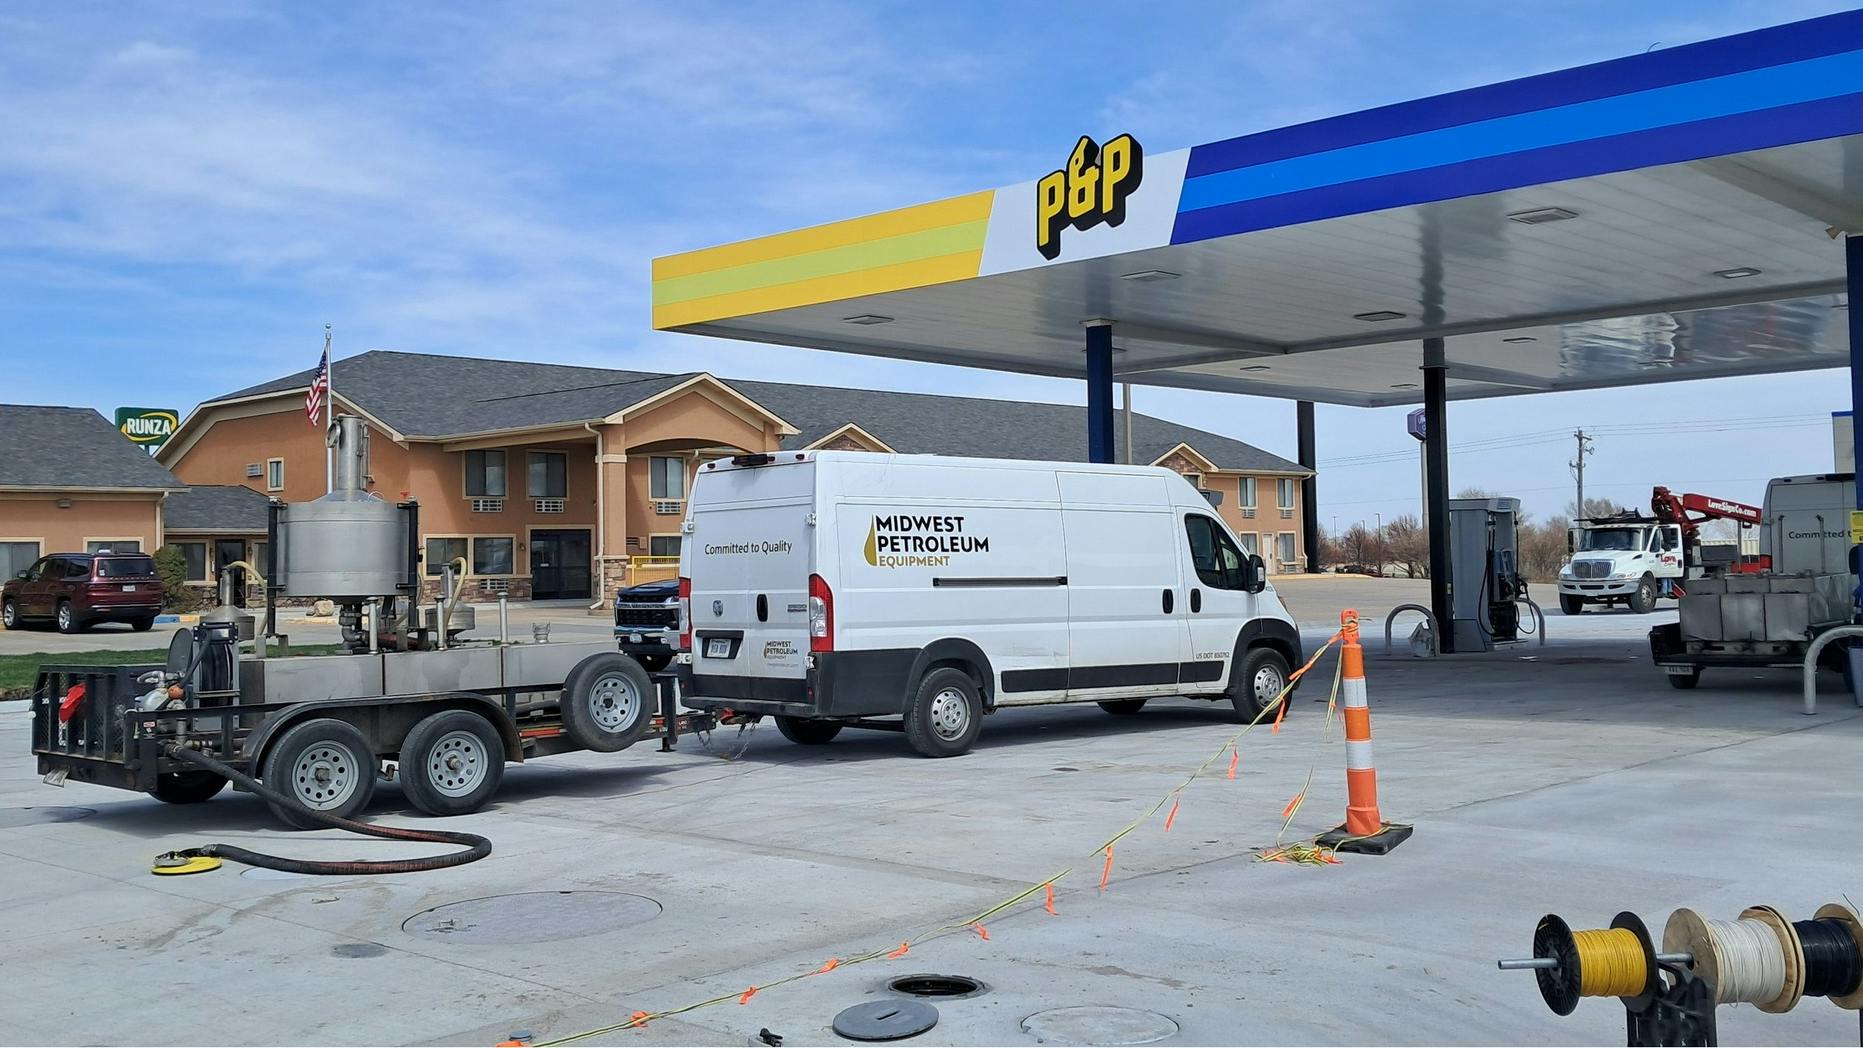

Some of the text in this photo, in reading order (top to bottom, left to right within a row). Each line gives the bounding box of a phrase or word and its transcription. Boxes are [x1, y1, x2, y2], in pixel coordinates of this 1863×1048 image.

[1037, 133, 1142, 260] P&P
[126, 418, 171, 435] RUNZA
[875, 515, 964, 532] MIDWEST
[1788, 529, 1845, 539] Commtted
[704, 540, 792, 555] Committed to Quality
[877, 535, 989, 553] PETROLEUM
[879, 555, 950, 569] EQUIPMENT
